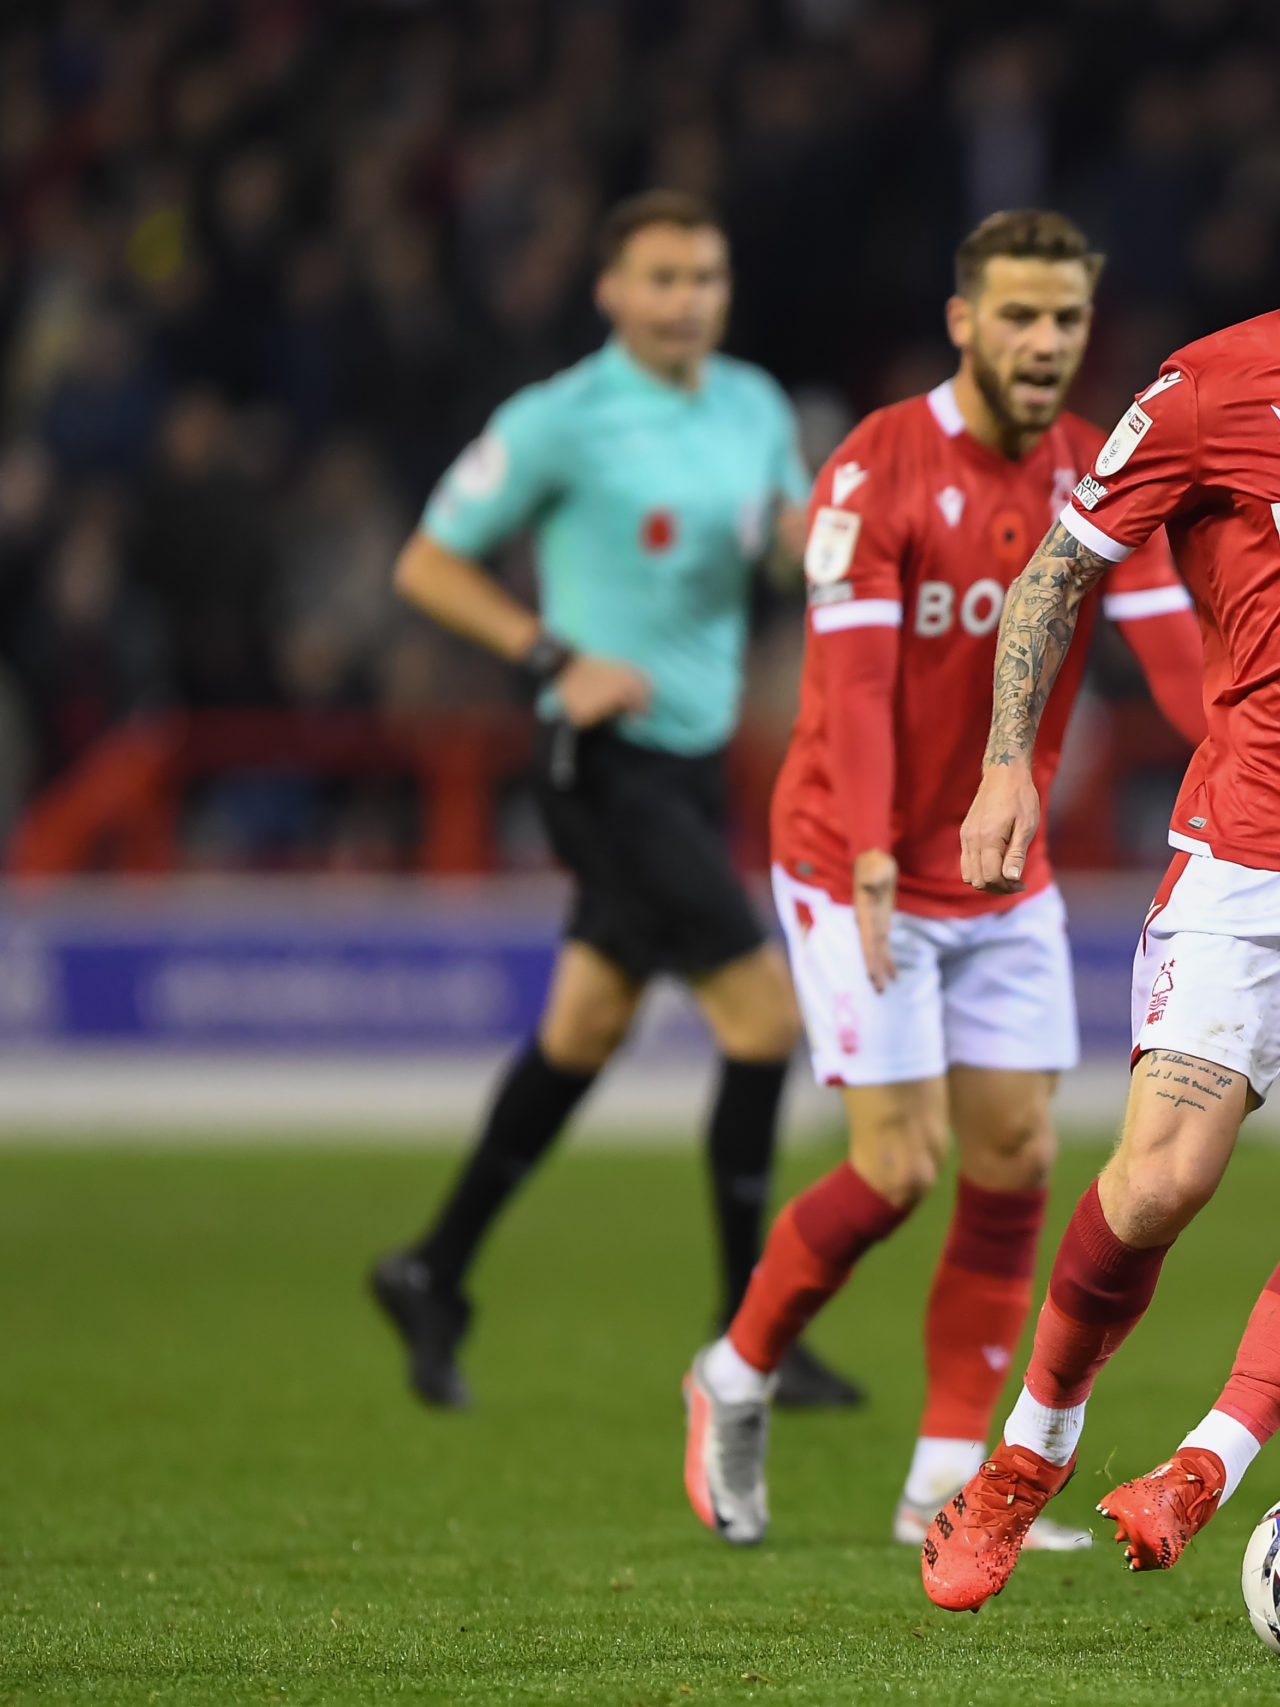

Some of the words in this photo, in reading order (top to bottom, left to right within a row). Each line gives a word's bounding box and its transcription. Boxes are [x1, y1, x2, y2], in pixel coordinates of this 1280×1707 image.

[915, 578, 1004, 638] BO
[1173, 1076, 1190, 1085] will
[1216, 1075, 1233, 1088] gift
